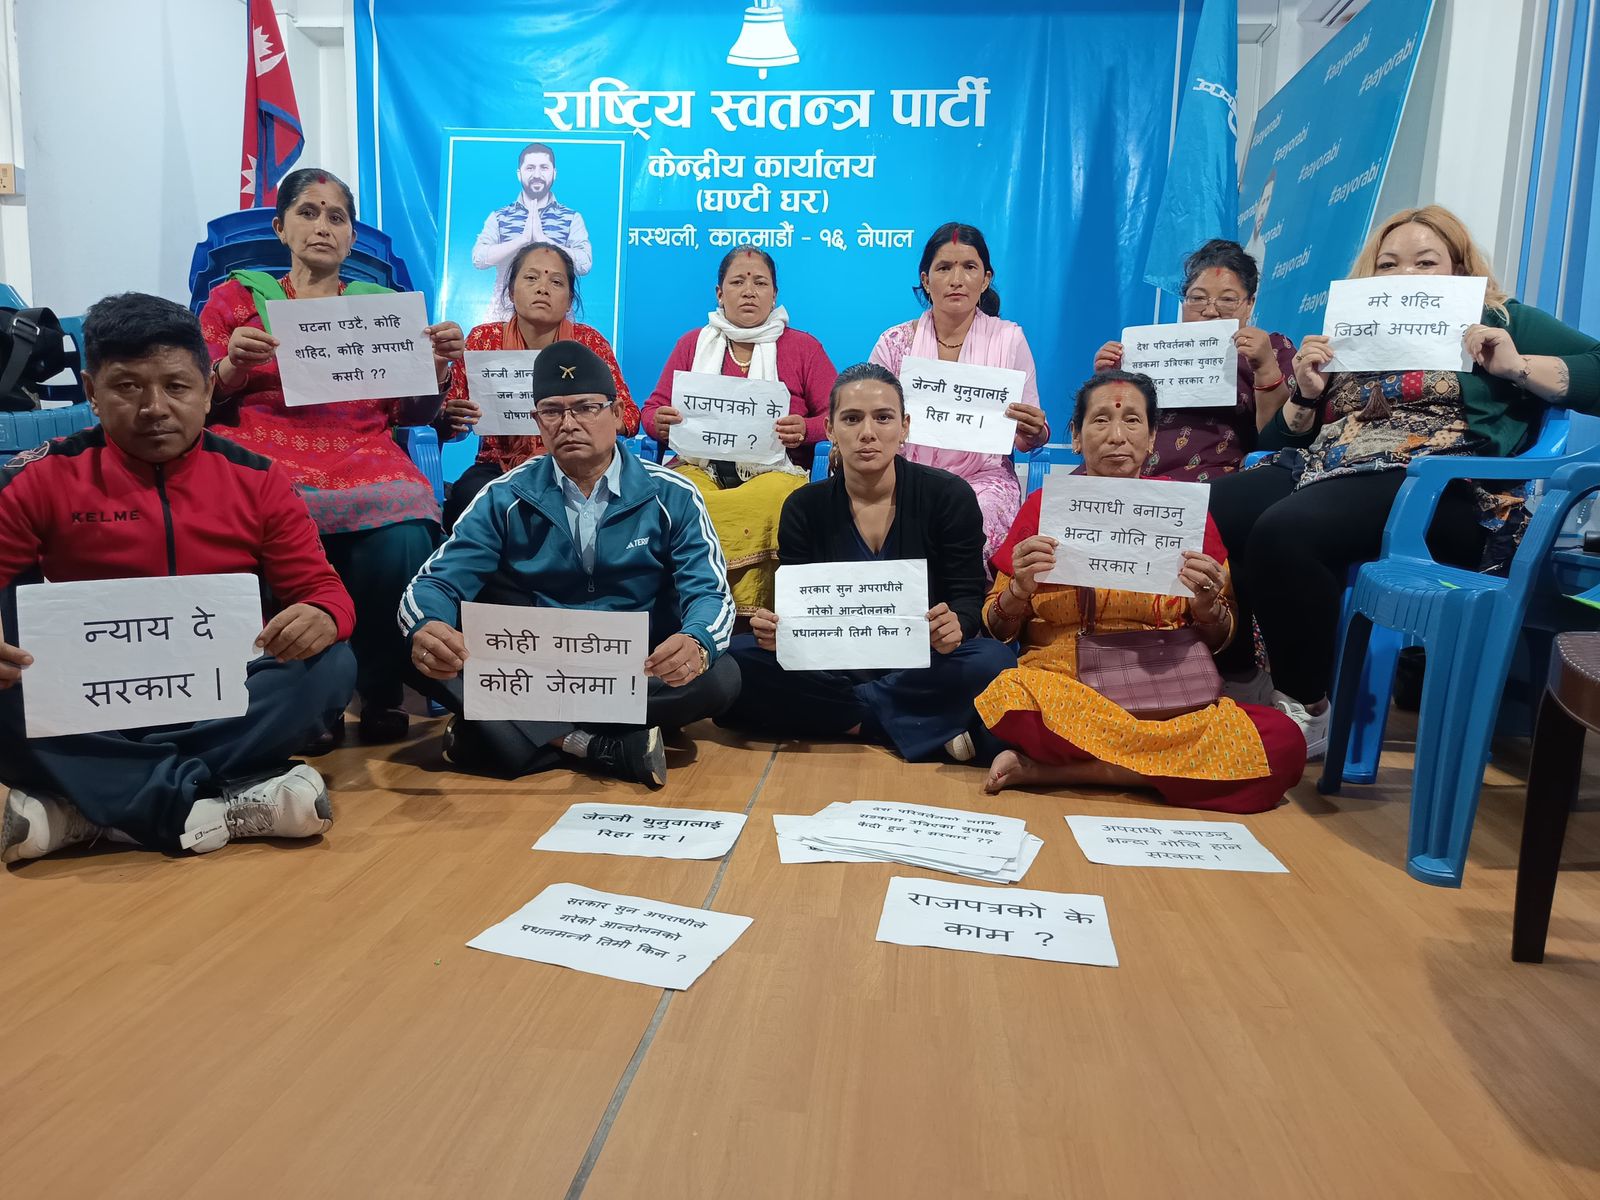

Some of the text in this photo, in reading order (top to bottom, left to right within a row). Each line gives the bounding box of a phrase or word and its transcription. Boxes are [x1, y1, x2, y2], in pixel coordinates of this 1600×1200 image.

[1323, 26, 1373, 85] #aayorabi
[1358, 31, 1418, 96] #aayorabi
[543, 75, 992, 141] राष्ट्रिय स्वतन्त्र पार्टी
[1272, 120, 1311, 165] #aayorabi
[647, 147, 877, 181] केन्द्रीय कार्यालय
[1297, 137, 1342, 184] #aayorabi
[1328, 157, 1382, 207] #aayorabi
[696, 183, 829, 214] (घण्टी घर)
[708, 221, 795, 248] काठमाडौं
[857, 222, 915, 248] नेपाल
[1272, 244, 1313, 280] #aayorabi
[1368, 291, 1445, 309] मरे शहिद
[299, 314, 402, 333] घटना एउटै, कोहि
[1334, 320, 1380, 338] जिउदो
[1387, 321, 1450, 337] अपराधी
[295, 338, 414, 360] शहिद, कोहि अपराधी
[1153, 338, 1196, 350] परिवर्तनको
[1199, 336, 1220, 347] लागि
[332, 367, 386, 382] कसरी ??
[481, 367, 509, 379] जेन्जी
[1132, 360, 1160, 369] सडकमा
[912, 376, 1010, 404] जेन्जी थुनुवालाई
[1169, 378, 1175, 386] र
[1178, 376, 1205, 386] सरकार
[1209, 375, 1221, 384] ??
[497, 391, 514, 400] जन
[683, 394, 783, 419] राजपत्रको के
[926, 405, 950, 423] रिहा
[956, 413, 974, 425] गर
[702, 430, 758, 450] काम ?
[72, 509, 141, 524] KELME
[1068, 498, 1186, 527] अपराधी बनाउनु
[1064, 526, 1184, 550] भन्दा गोलि हान
[1088, 557, 1151, 576] सरकार !
[799, 580, 904, 598] सरकार सुन अपराधीले
[807, 602, 897, 616] गरेको आन्दोलनको
[83, 606, 216, 643] न्याय दे
[792, 625, 912, 639] प्रधानमन्त्री तिमी किन ?
[485, 628, 632, 656] कोही गाडीमा
[82, 672, 196, 708] सरकार
[479, 668, 636, 696] कोही जेलमा !
[582, 811, 725, 831] जेन्जी थुनुवालाई
[597, 828, 635, 840] रिहा
[643, 832, 672, 842] गर
[928, 831, 972, 840] सरकार
[976, 837, 994, 845] ??
[1101, 824, 1235, 842] अपराधी बनाउनु
[1105, 836, 1243, 851] भन्दा गोलि हान
[1144, 850, 1206, 861] सरकार
[567, 896, 709, 931] सरकार सुन अपराधीले
[907, 891, 1096, 926] राजपत्रको के
[559, 913, 683, 943] गरेको आन्दोलनको
[943, 921, 1054, 947] काम ?
[520, 923, 688, 964] प्रधानमन्त्री तिमी किन ?
